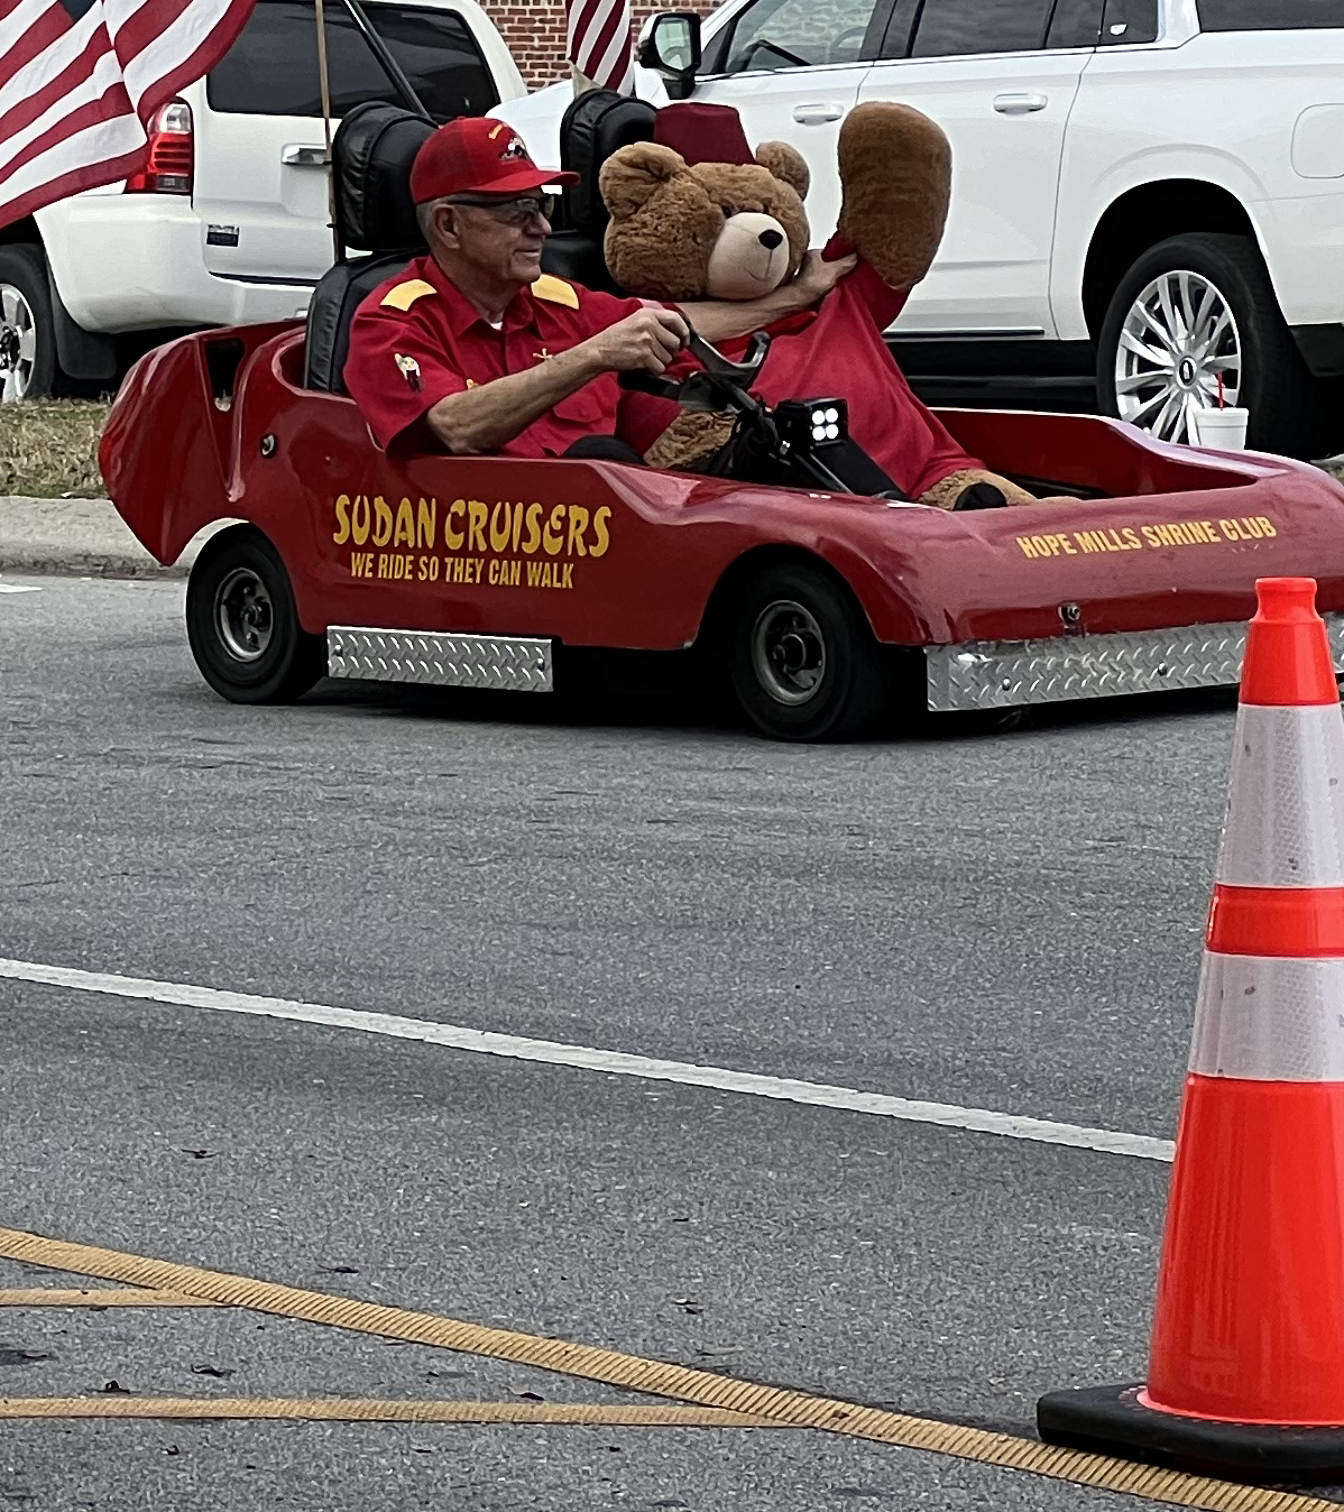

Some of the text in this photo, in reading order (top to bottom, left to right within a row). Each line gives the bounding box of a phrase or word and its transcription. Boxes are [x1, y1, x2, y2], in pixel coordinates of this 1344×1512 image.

[333, 494, 612, 558] SUDAN CRUISERS
[1016, 516, 1277, 559] HOPE MILLS SHRINE CLUB
[351, 552, 574, 589] WE RIDE SO THEY CAN WALK
